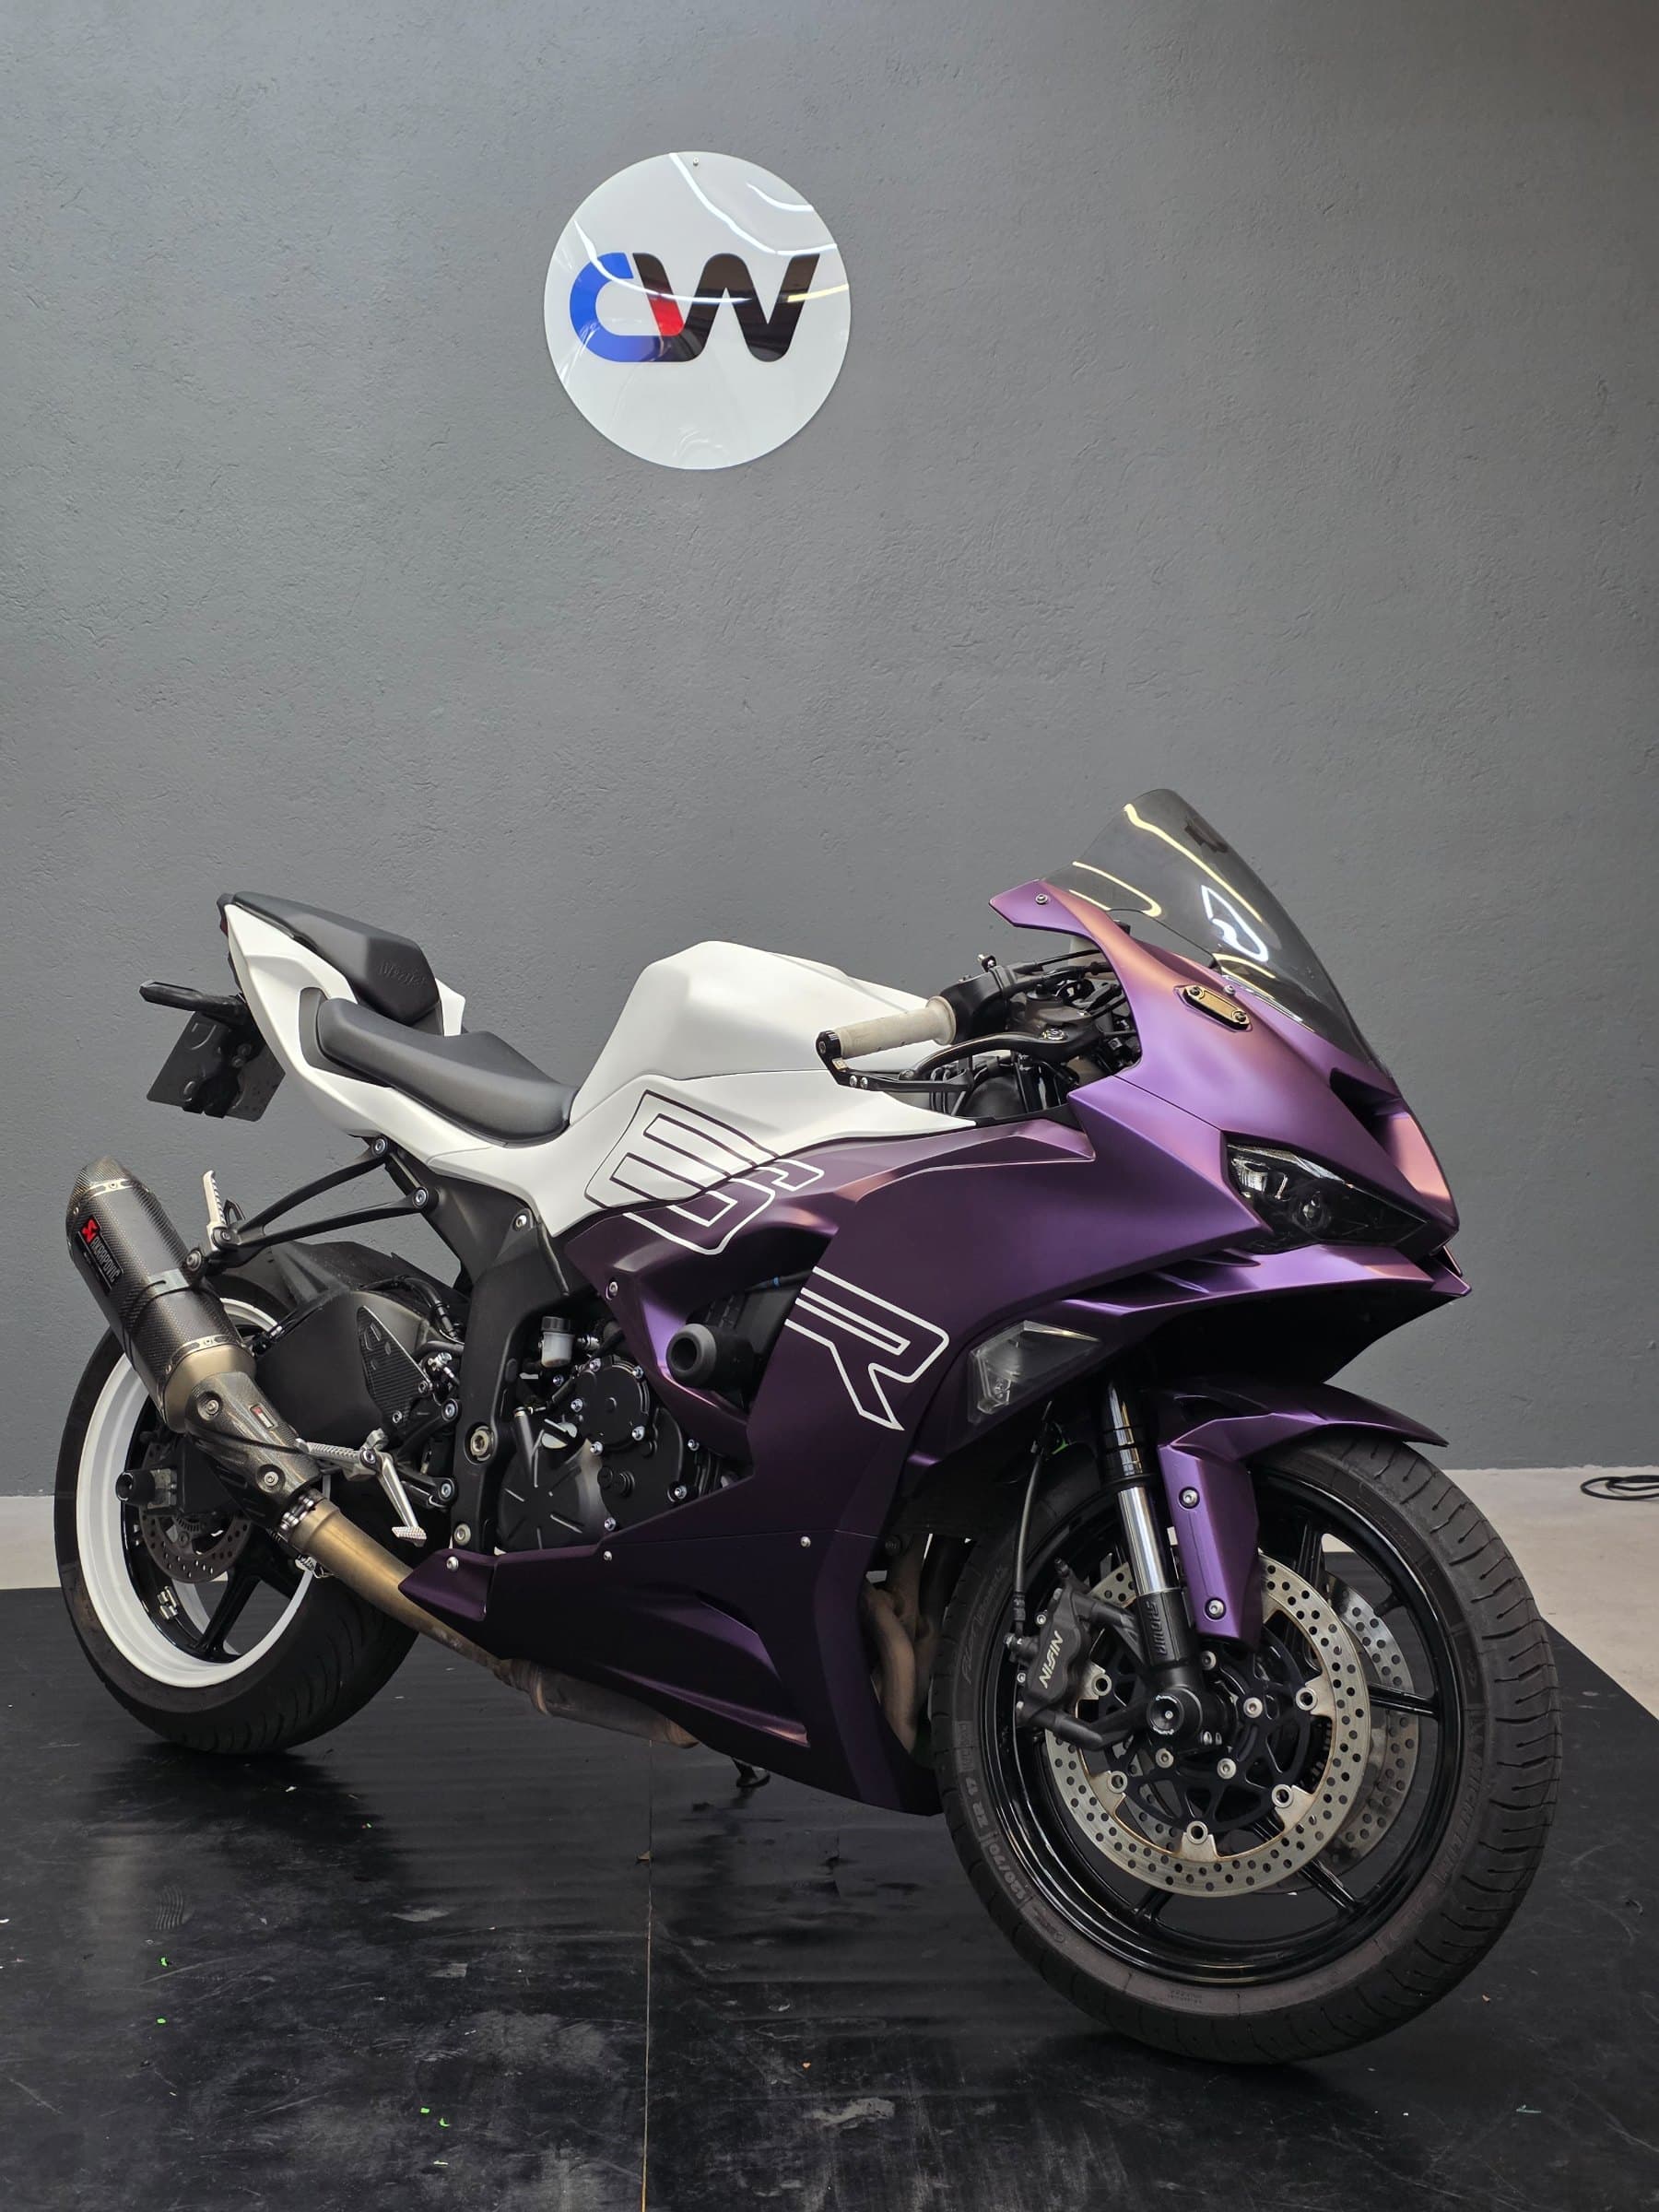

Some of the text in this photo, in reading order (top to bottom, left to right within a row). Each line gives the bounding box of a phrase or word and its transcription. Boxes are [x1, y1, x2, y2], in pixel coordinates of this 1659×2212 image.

[1039, 1630, 1064, 1689] NISSIN
[965, 1777, 979, 1796] 17
[988, 1841, 1026, 1900] 120/70
